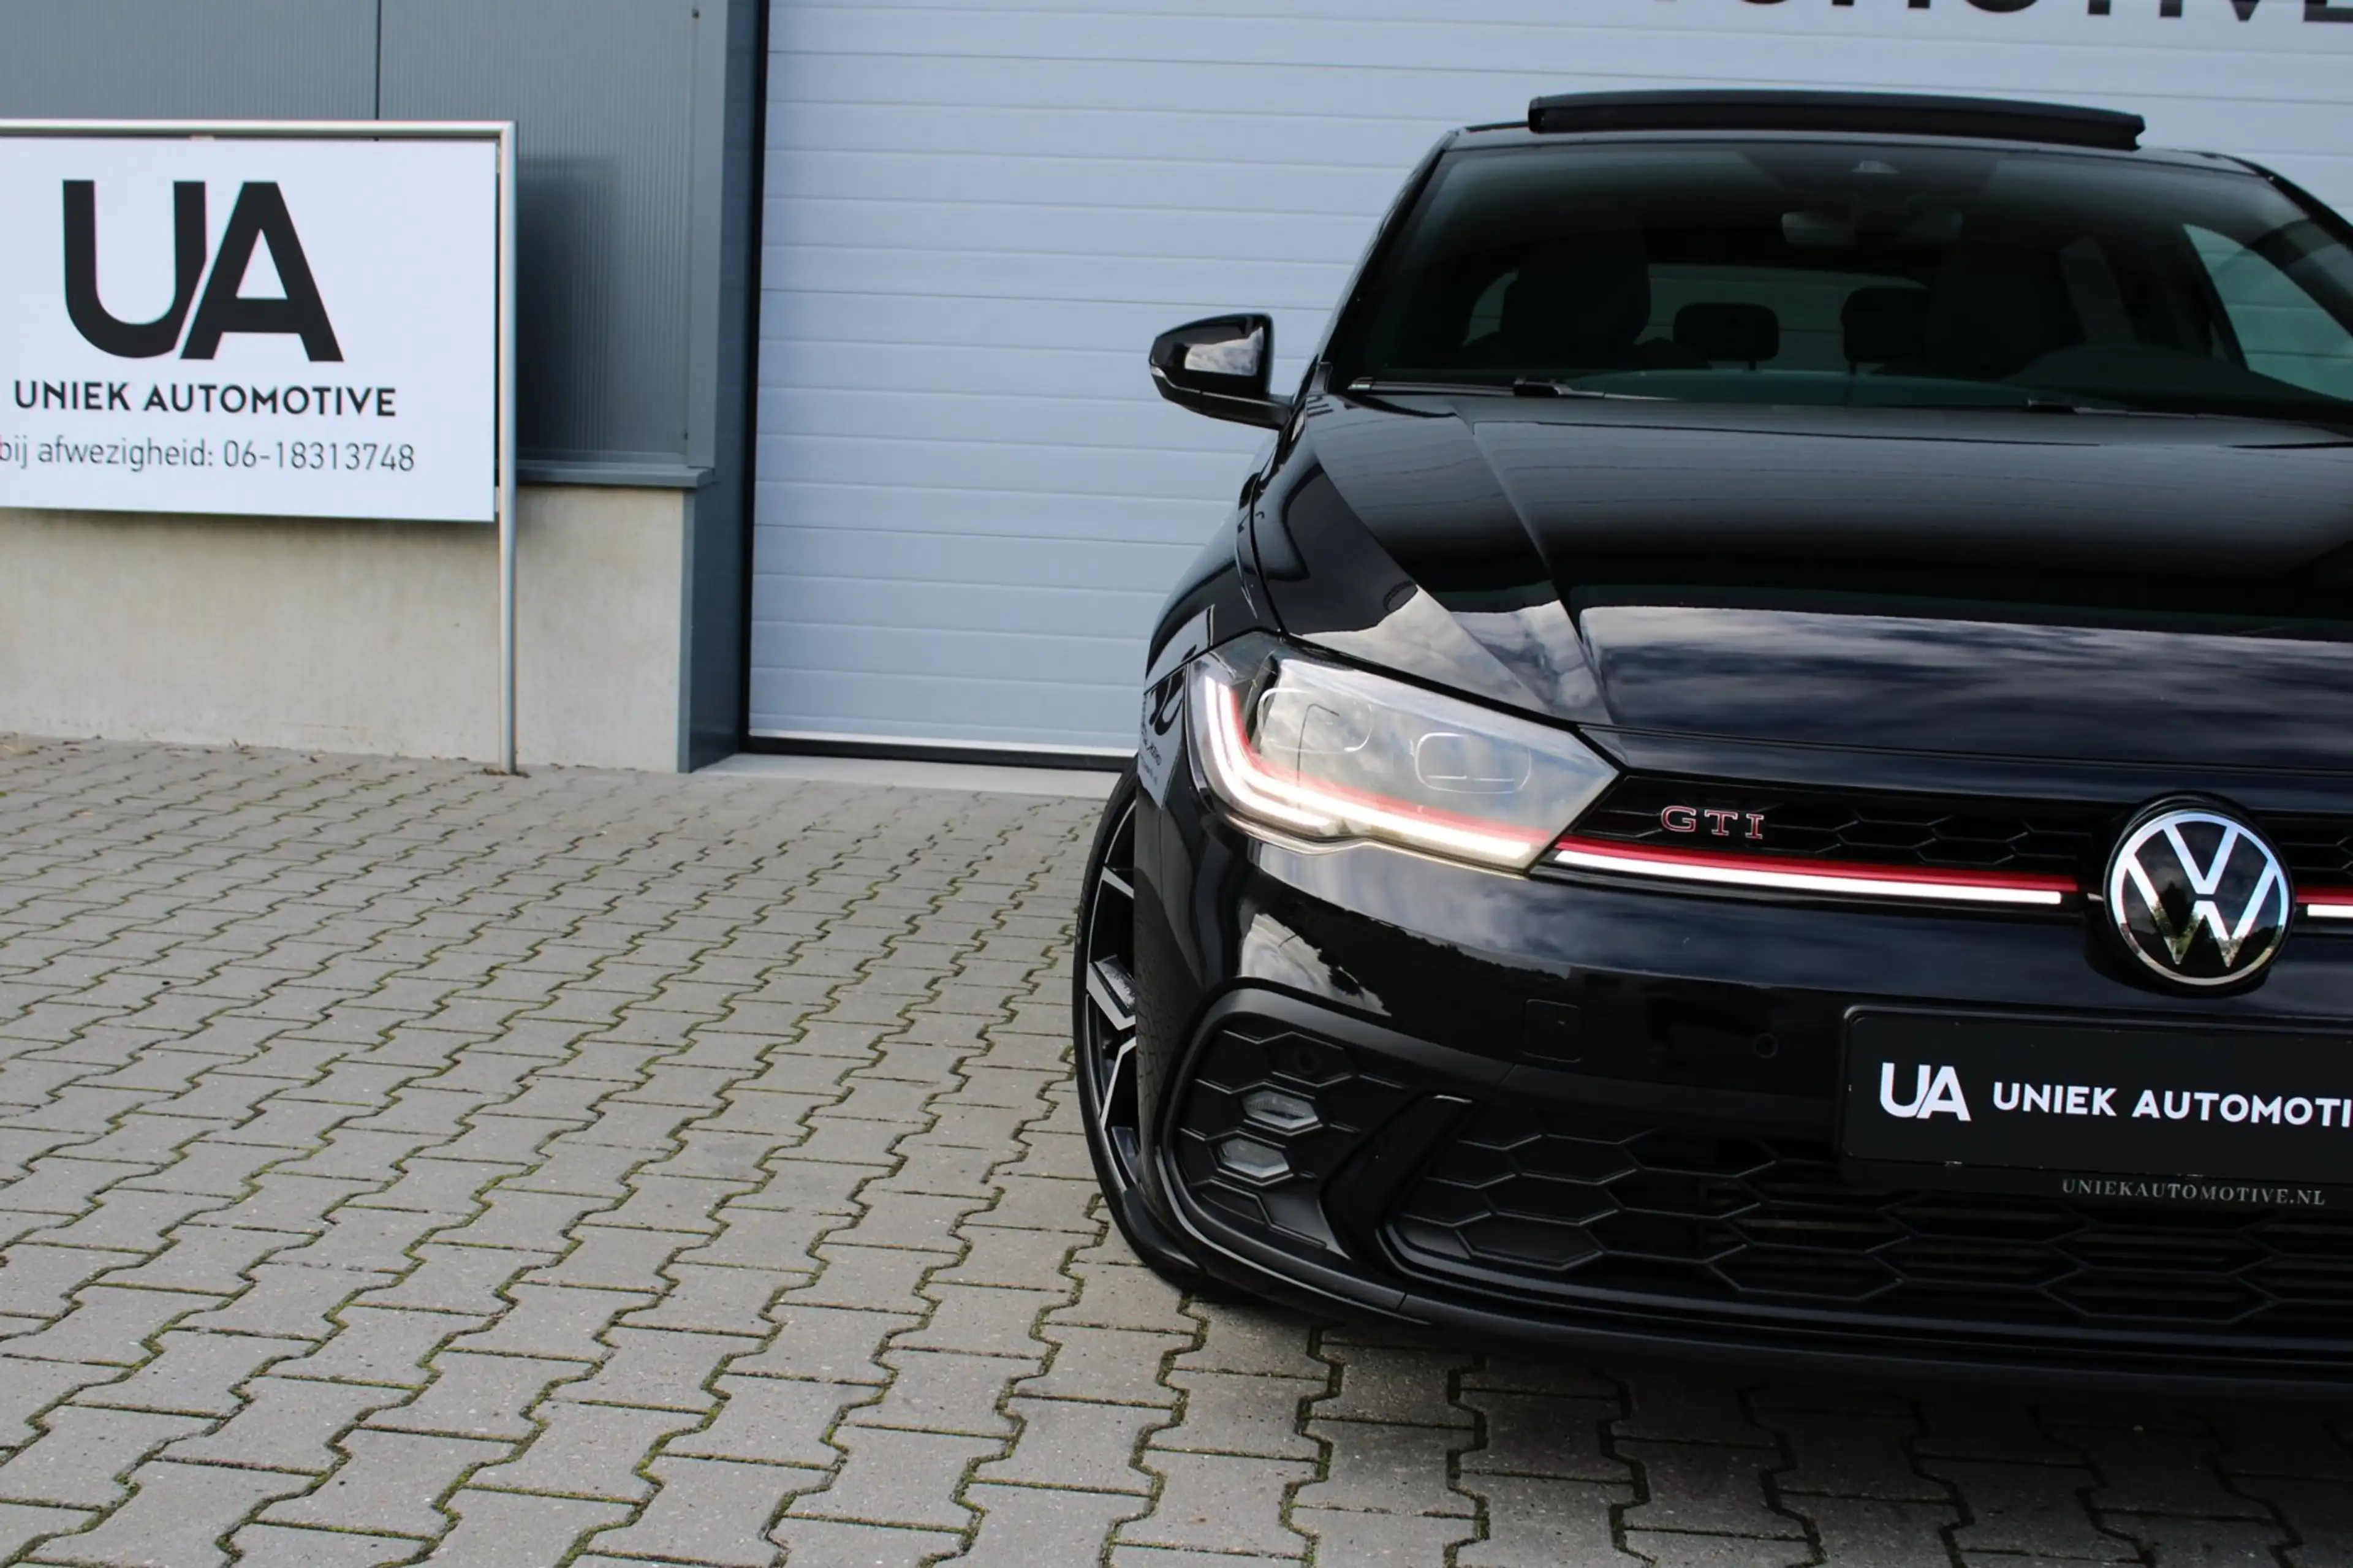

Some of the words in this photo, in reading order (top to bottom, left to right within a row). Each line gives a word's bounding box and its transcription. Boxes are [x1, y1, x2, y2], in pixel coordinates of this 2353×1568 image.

[62, 179, 345, 363] UA
[14, 380, 131, 412] UNIEK
[143, 383, 396, 417] AUTOMOTIVE
[0, 434, 28, 469] bij
[37, 435, 214, 473] afwezigheid:
[223, 439, 415, 472] 06-18313748
[1661, 805, 1765, 839] GTI
[1879, 1061, 1972, 1122] UA
[1993, 1081, 2117, 1117] UNIEK
[2131, 1089, 2352, 1128] AUTOMOTI
[2062, 1178, 2326, 1206] UNIEKAUTOMOTIVE.NL
